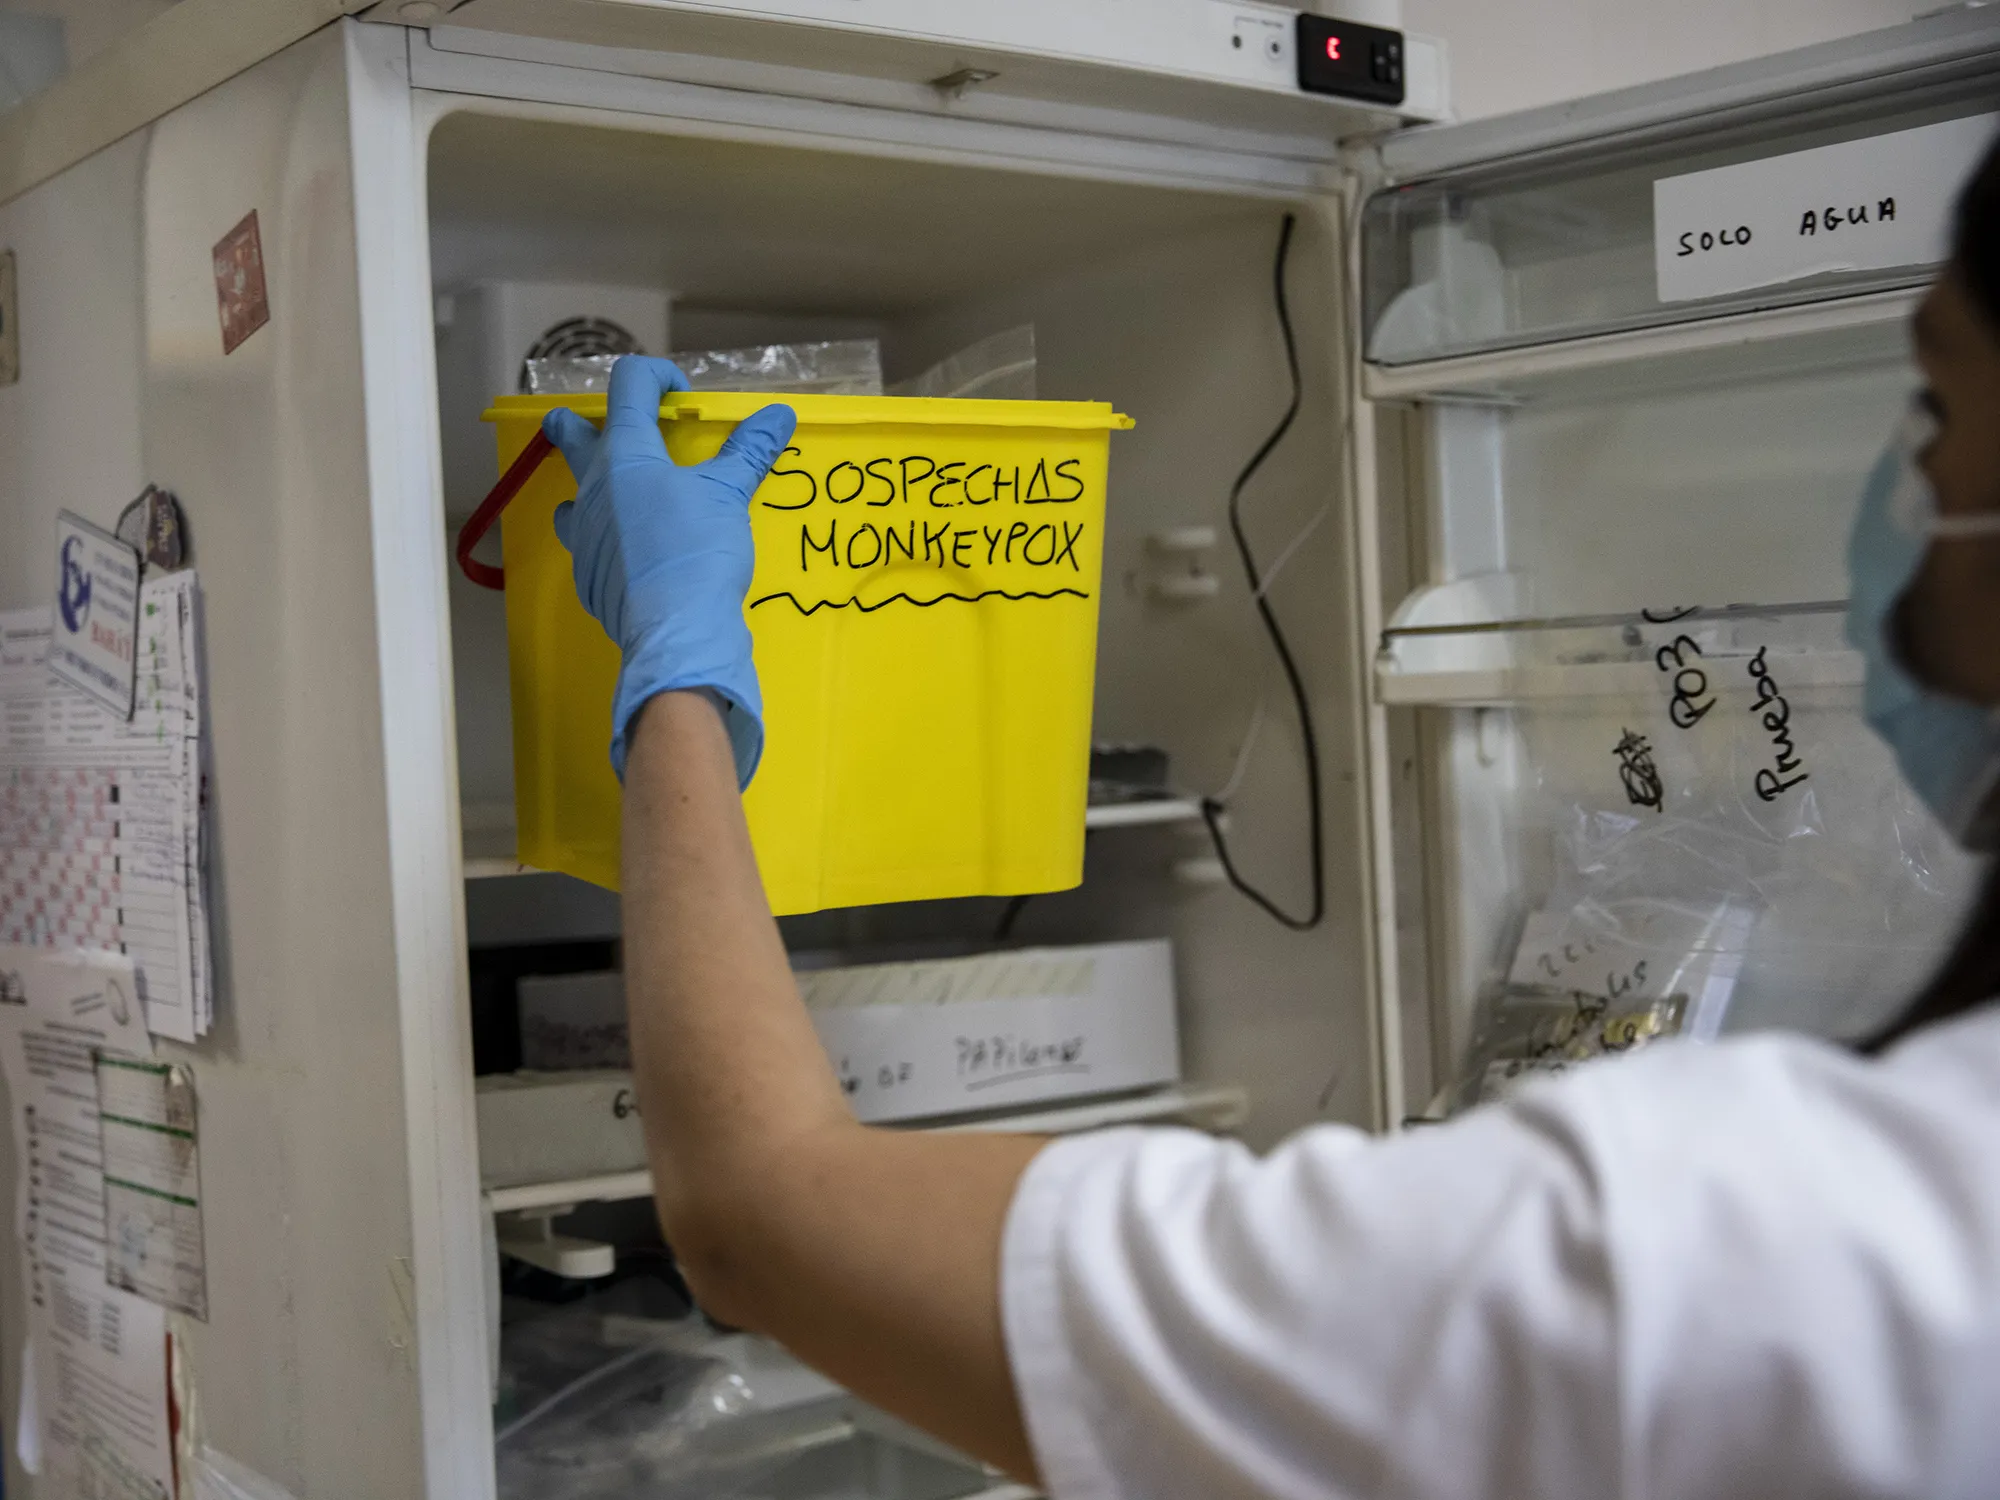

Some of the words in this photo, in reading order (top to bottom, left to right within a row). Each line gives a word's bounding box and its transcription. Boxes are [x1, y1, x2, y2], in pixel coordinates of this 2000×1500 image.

[1676, 225, 1753, 257] SOLO
[1799, 197, 1897, 236] AGUA
[761, 446, 1084, 511] SOSPECHAS
[801, 518, 1084, 572] MONKEYPOX
[1748, 645, 1809, 802] Prueba
